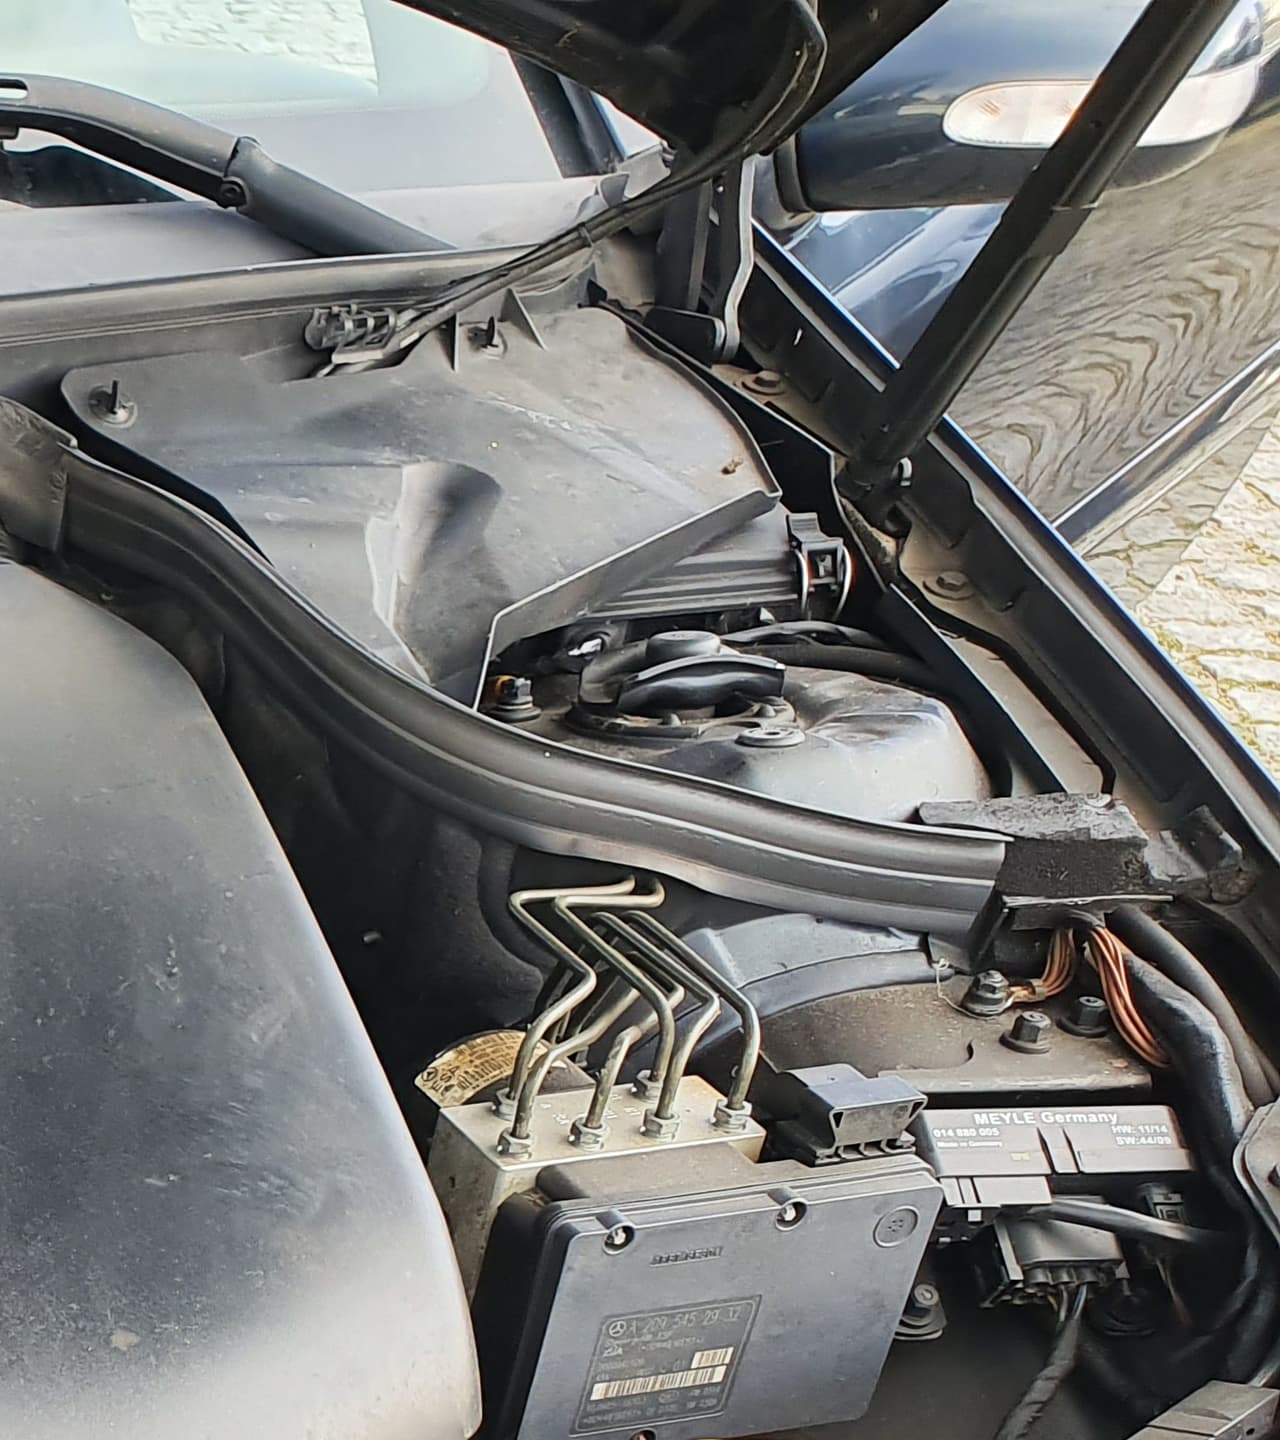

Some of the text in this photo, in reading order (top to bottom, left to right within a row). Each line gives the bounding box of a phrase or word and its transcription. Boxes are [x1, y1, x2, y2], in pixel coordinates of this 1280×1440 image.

[973, 1111, 1118, 1125] MEYLE Germany
[932, 1128, 954, 1137] 014
[702, 1309, 721, 1325] 29
